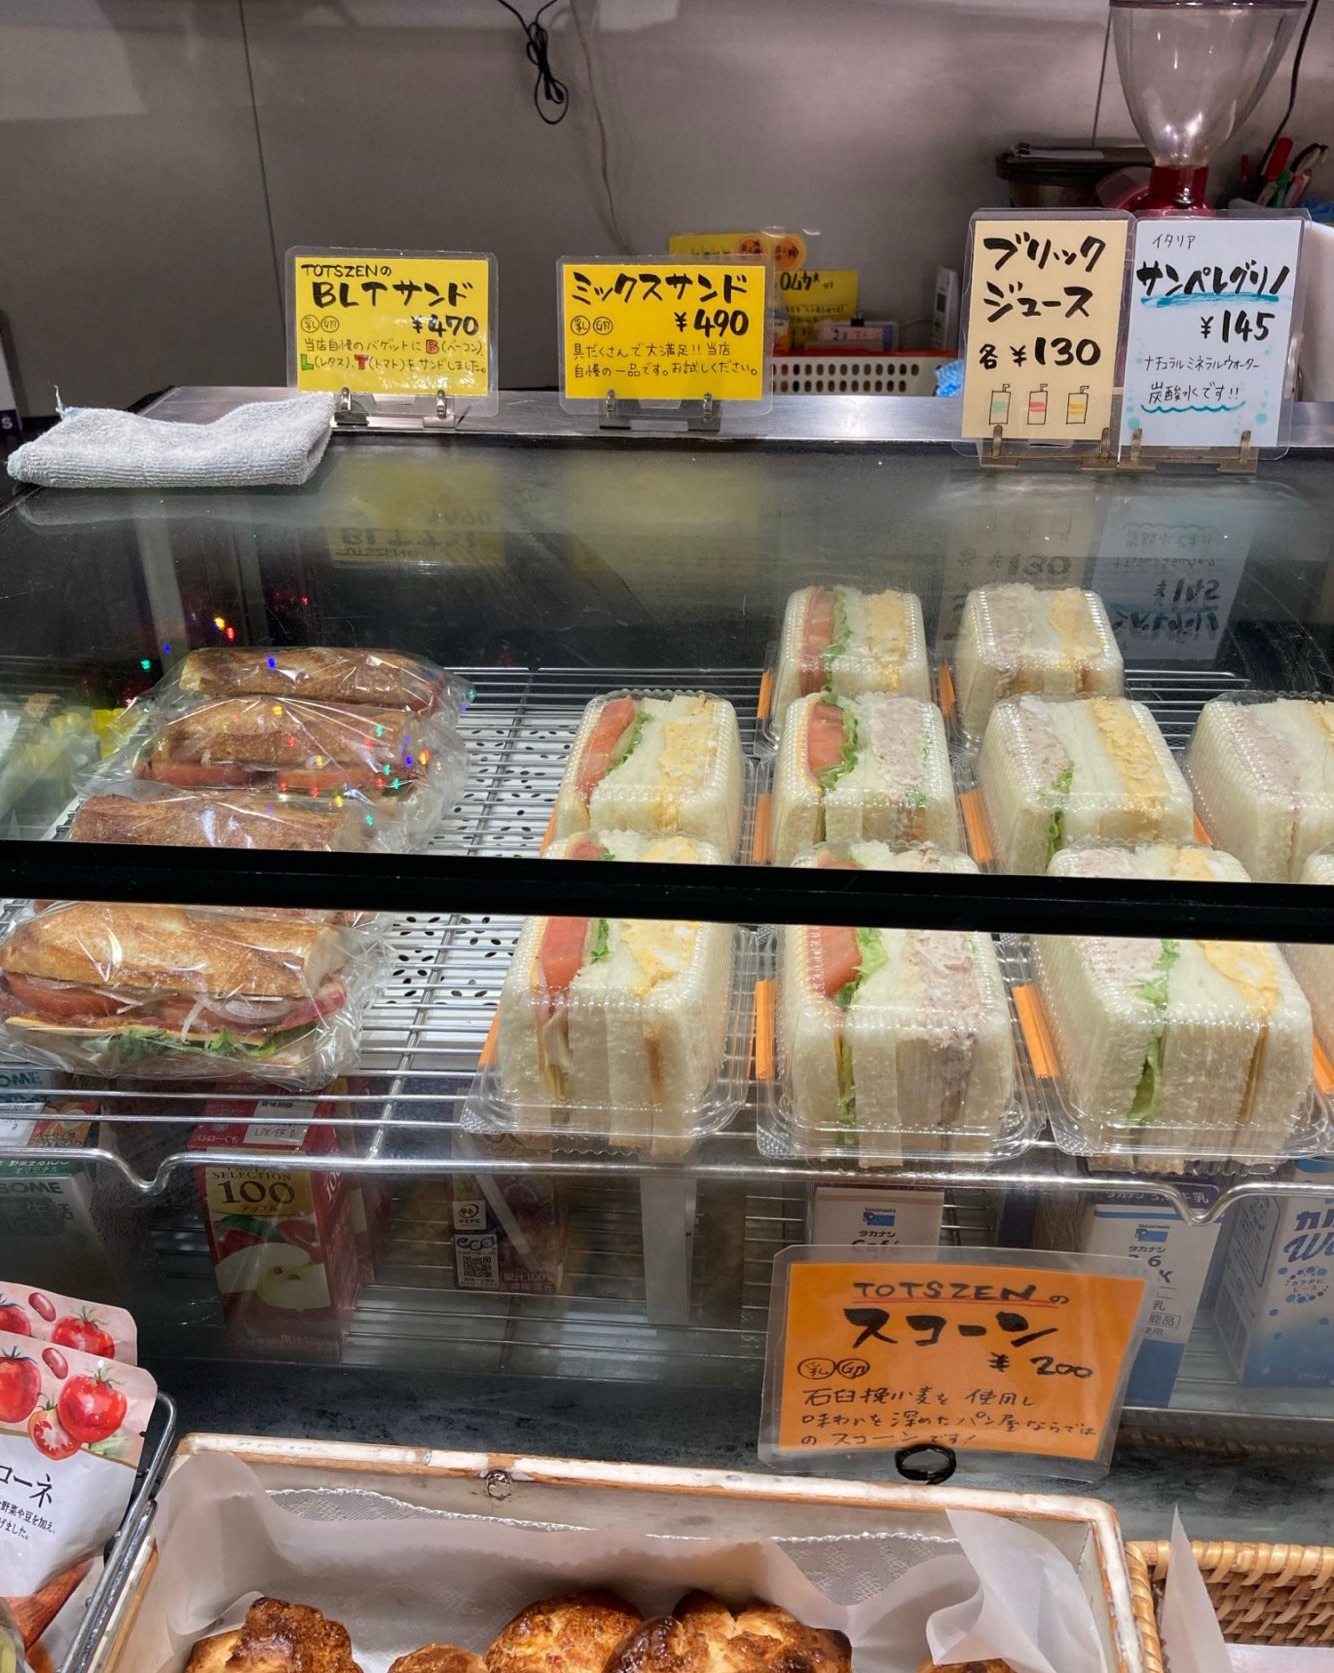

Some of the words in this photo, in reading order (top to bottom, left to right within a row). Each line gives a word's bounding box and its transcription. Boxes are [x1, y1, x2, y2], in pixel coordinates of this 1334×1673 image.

[983, 231, 1106, 272] ブリック
[1152, 233, 1196, 250] イタリア
[301, 264, 392, 278] TOTSZENの
[1136, 260, 1290, 296] サンペレグリノ
[312, 280, 473, 308] BLTサンド
[571, 272, 747, 305] ミックスサンド
[982, 281, 1093, 322] ジュース
[411, 314, 479, 337] ¥470
[675, 309, 749, 337] ¥490
[1200, 310, 1275, 342] ¥145
[978, 344, 999, 369] 各
[1011, 337, 1101, 368] ¥130
[217, 1180, 296, 1205] 100
[853, 1281, 1070, 1305] TOTSZENの
[844, 1308, 1058, 1348] スコーン
